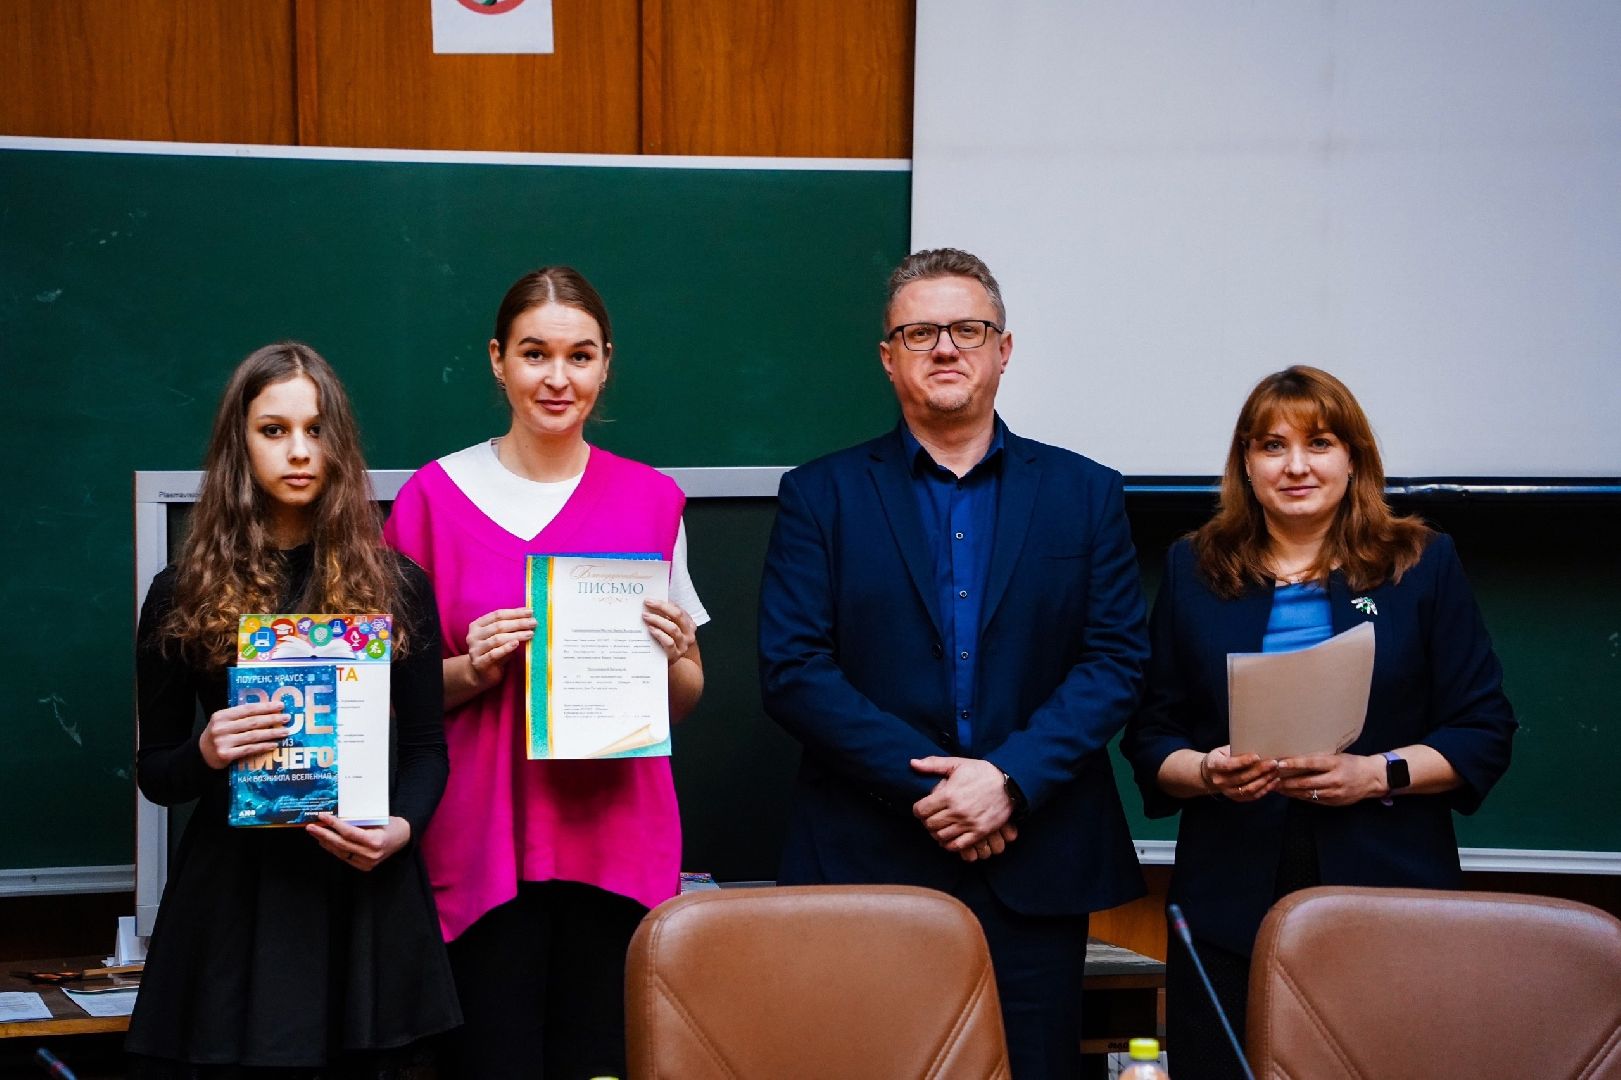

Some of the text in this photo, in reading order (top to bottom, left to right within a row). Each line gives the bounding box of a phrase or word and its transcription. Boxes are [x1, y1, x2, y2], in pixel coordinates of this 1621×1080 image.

[577, 581, 644, 595] ПИСЬМО
[274, 673, 304, 683] КРАУСС
[282, 737, 294, 747] ИЗ
